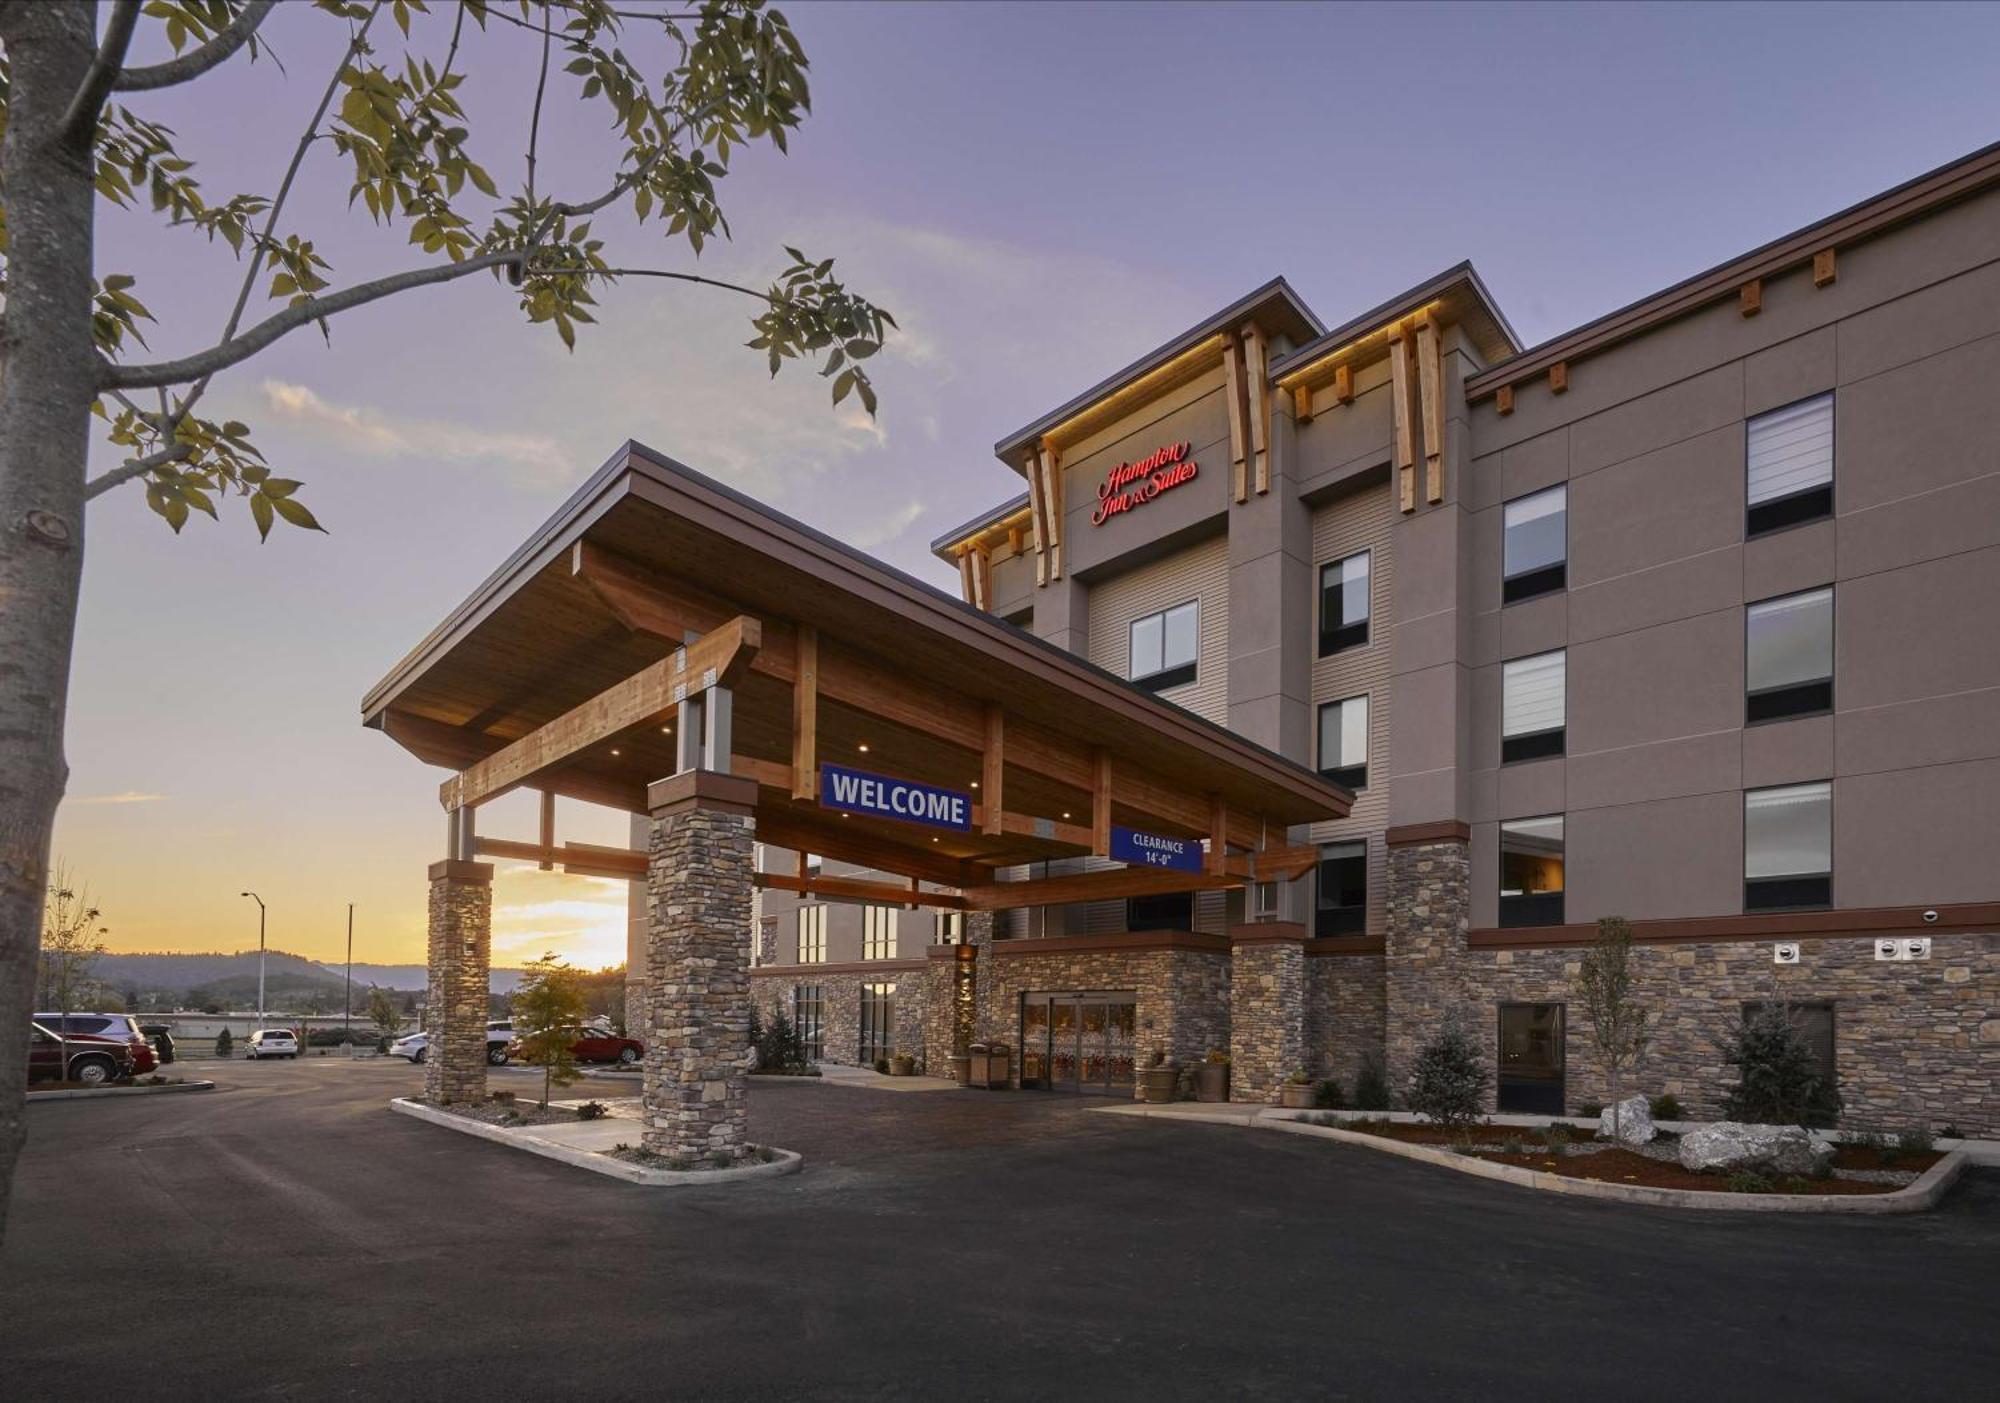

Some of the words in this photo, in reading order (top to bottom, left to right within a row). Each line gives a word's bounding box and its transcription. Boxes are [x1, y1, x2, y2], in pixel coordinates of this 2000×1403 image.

[1091, 493, 1132, 526] Inn
[1146, 461, 1198, 497] Suites
[1097, 440, 1190, 500] Hampton
[832, 773, 963, 824] WELCOME
[1133, 833, 1184, 854] CLEARANCE
[1146, 851, 1171, 865] 14'-0"
